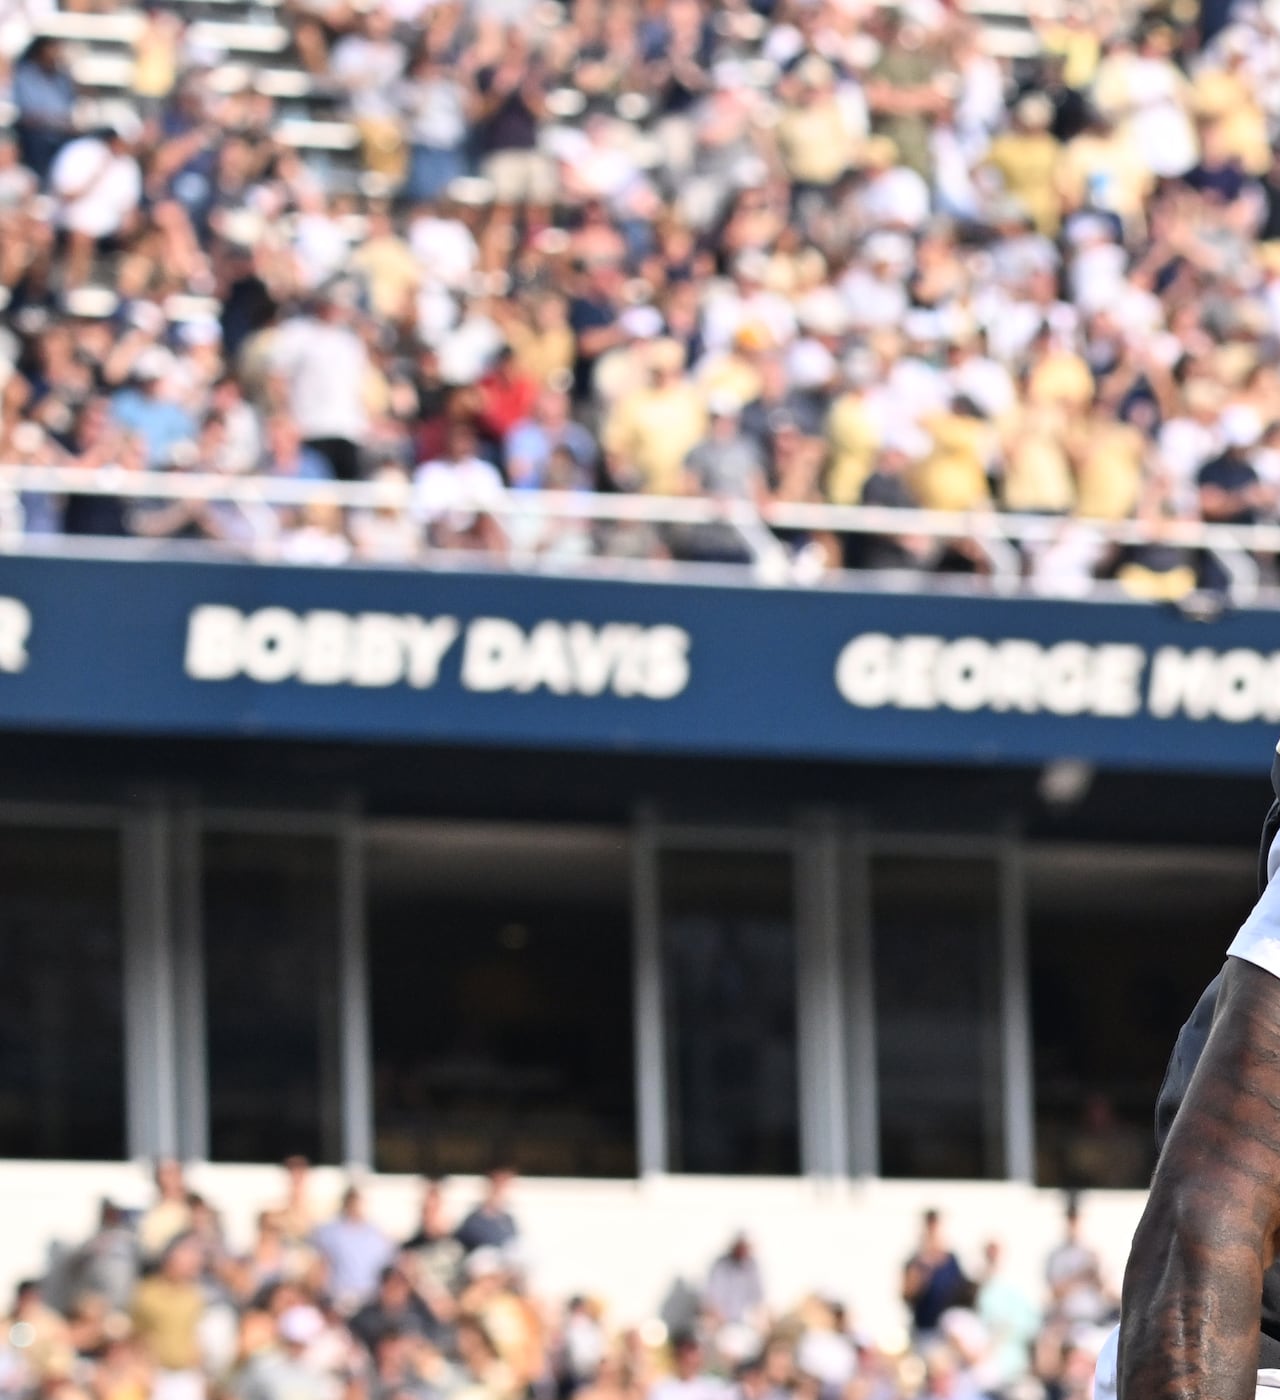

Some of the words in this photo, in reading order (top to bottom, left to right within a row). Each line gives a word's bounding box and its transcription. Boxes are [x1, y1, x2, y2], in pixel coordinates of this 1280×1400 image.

[184, 603, 462, 691] BOBBY
[460, 616, 690, 700] DAVIS
[835, 632, 1147, 717] GEORGE
